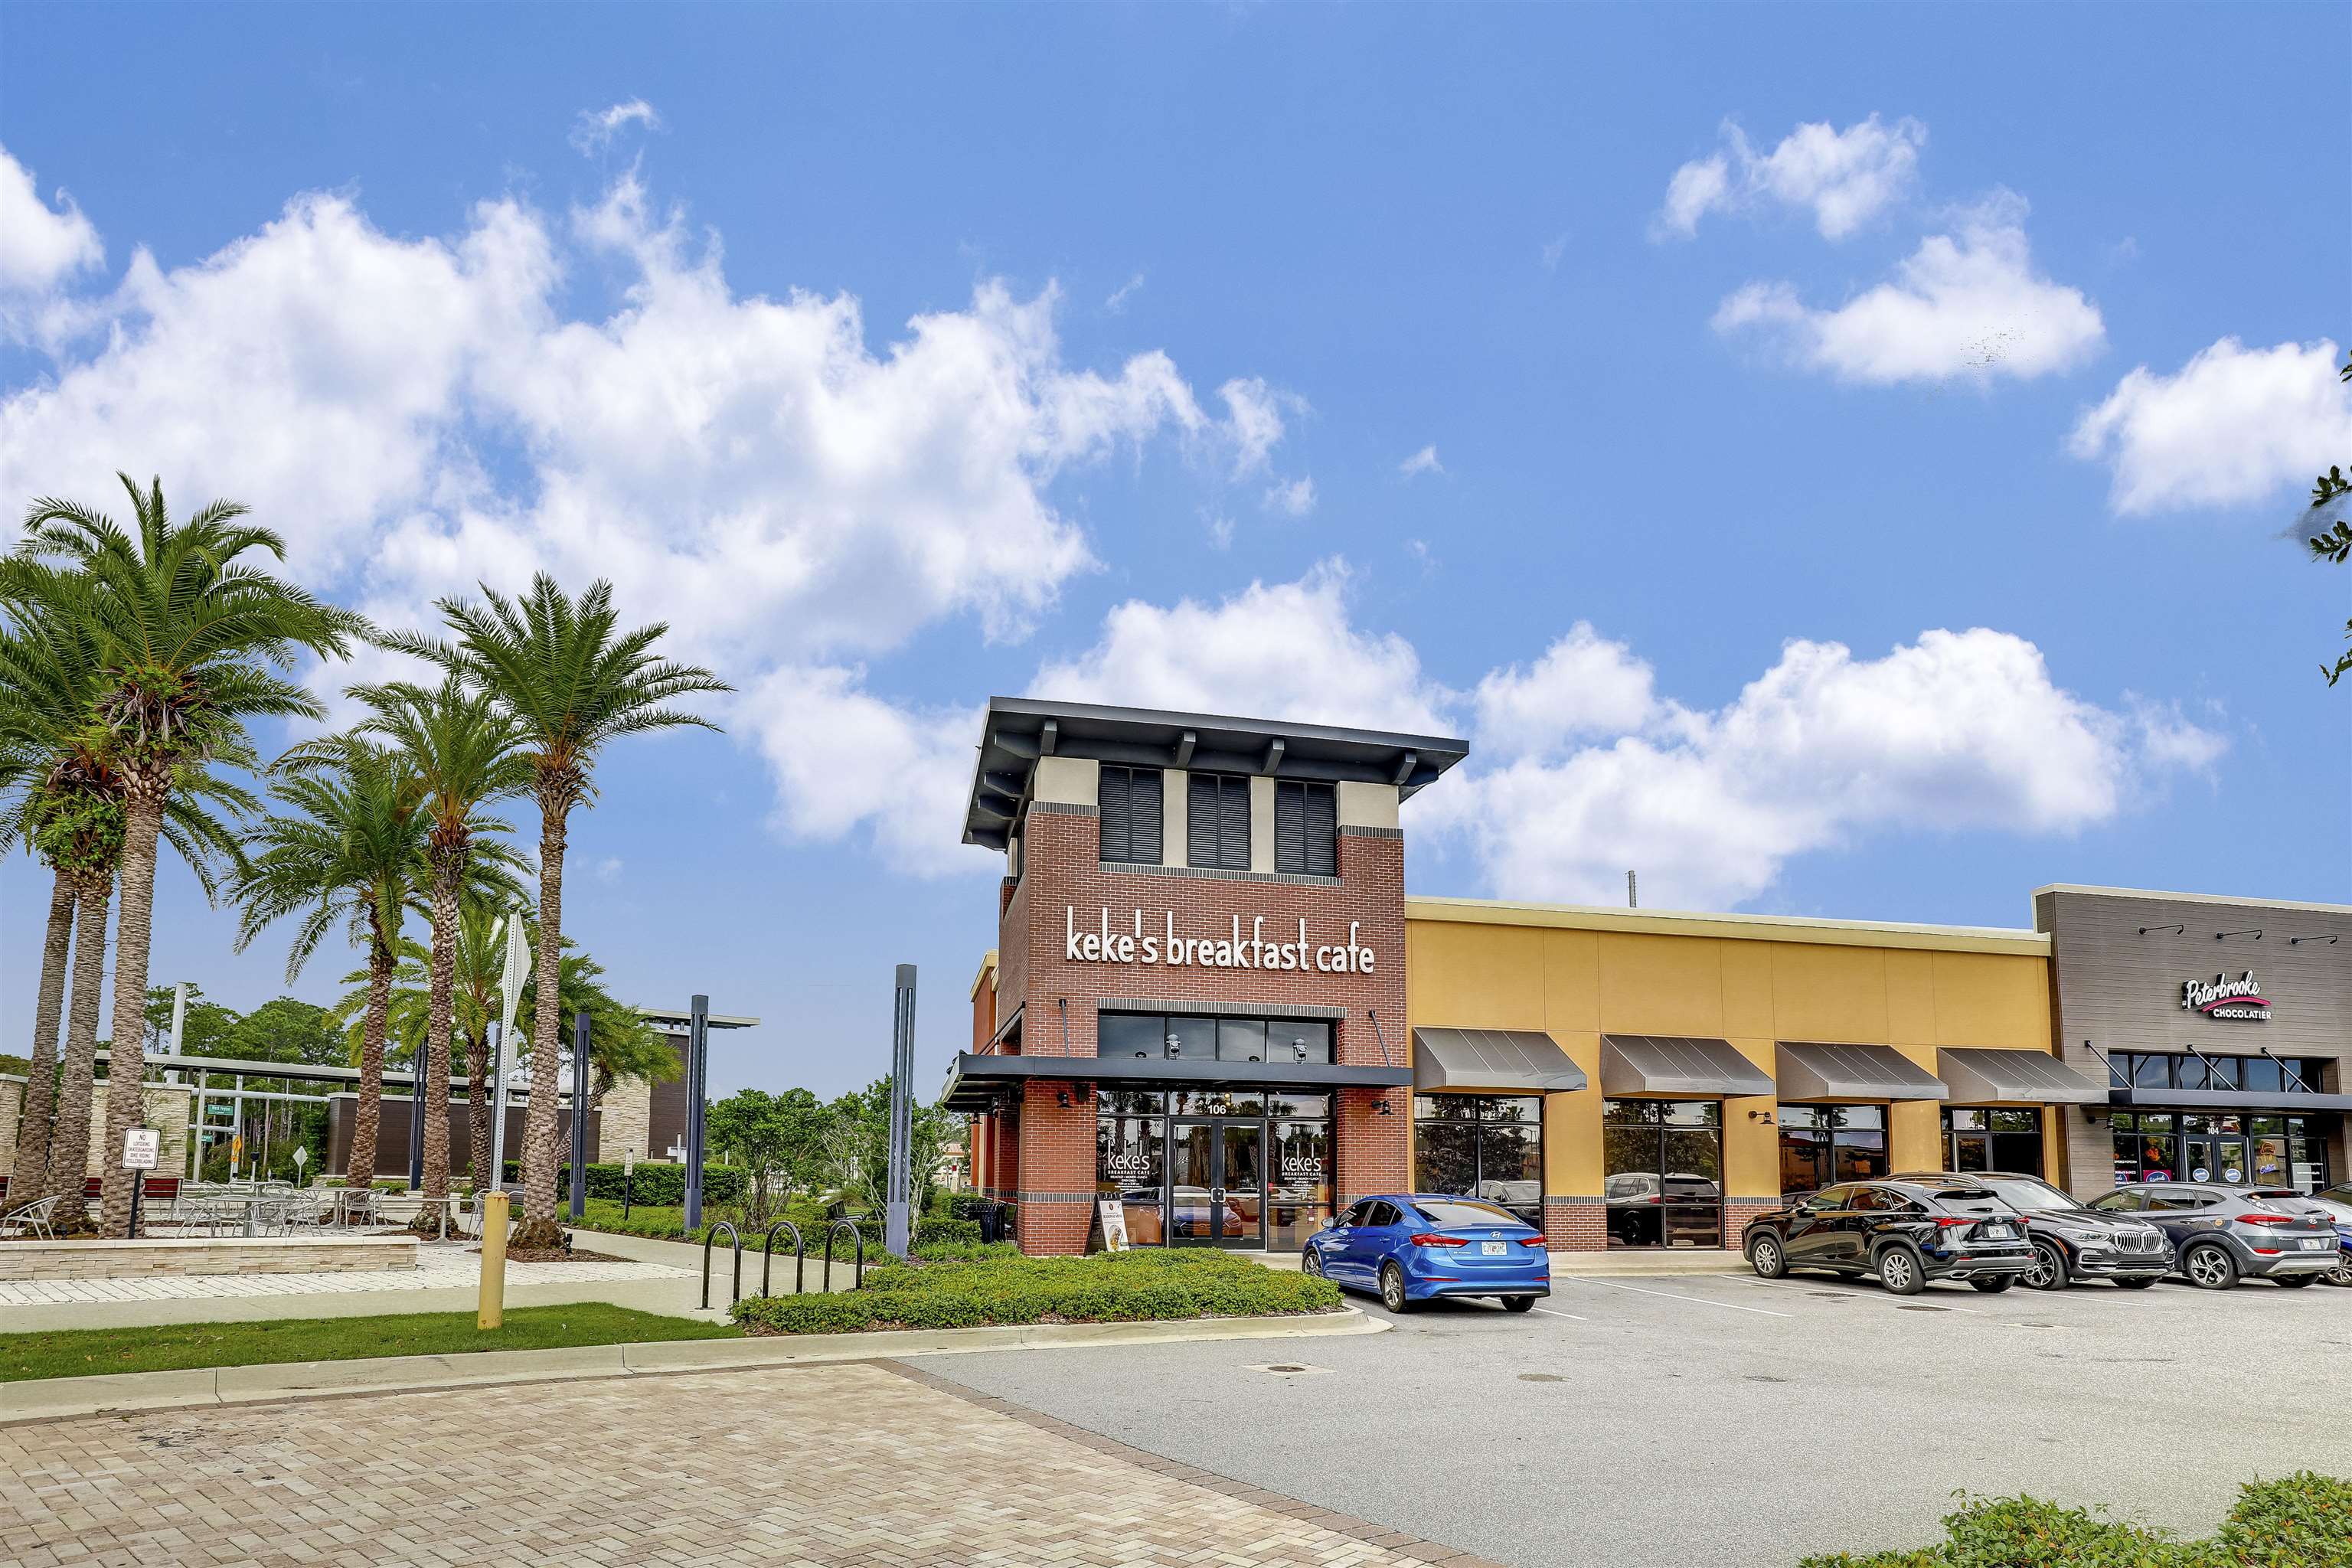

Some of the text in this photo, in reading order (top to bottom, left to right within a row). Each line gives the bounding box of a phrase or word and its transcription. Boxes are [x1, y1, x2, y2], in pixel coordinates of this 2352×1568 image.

[1066, 905, 1376, 974] keke's breakfast cafe
[2187, 969, 2261, 1009] Peterbrooke
[2213, 1008, 2272, 1020] CHOCOLATIER
[1208, 1104, 1227, 1115] 106
[2207, 1126, 2220, 1135] 104
[1108, 1139, 1150, 1170] keke's
[1282, 1142, 1321, 1171] keke's
